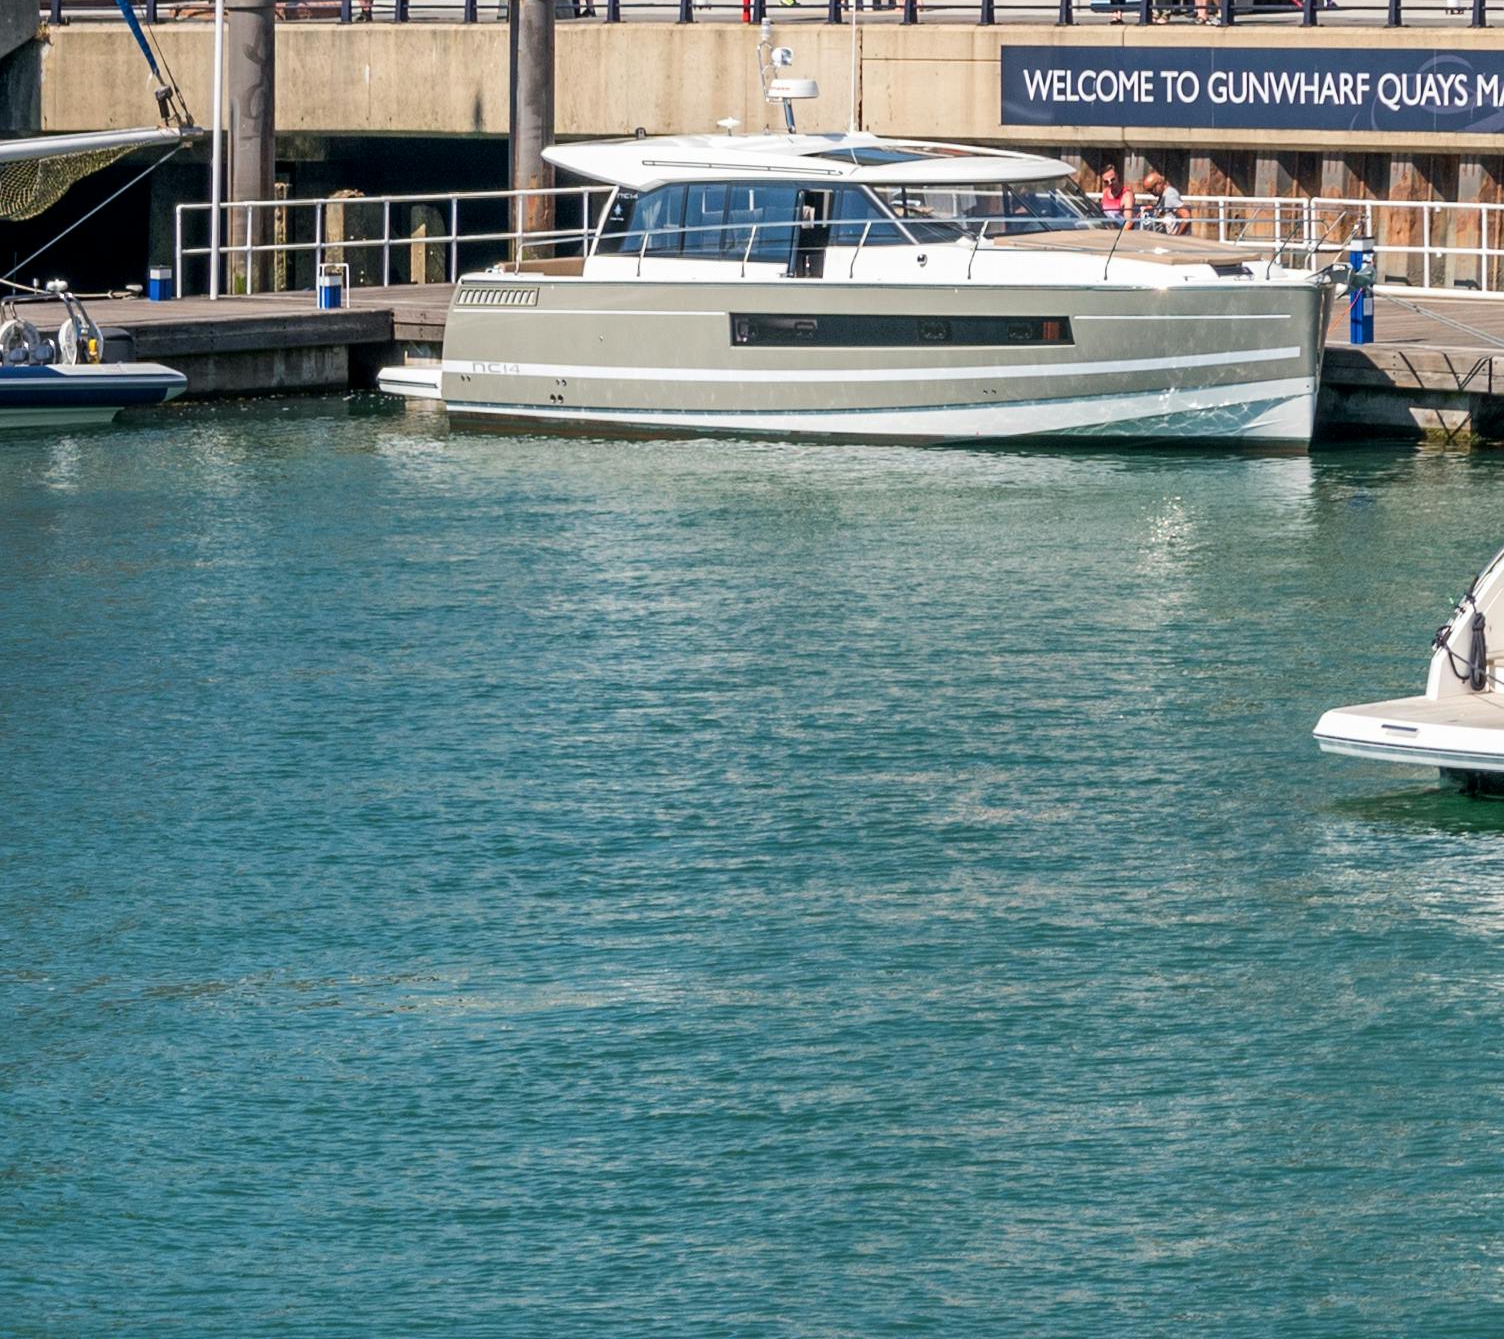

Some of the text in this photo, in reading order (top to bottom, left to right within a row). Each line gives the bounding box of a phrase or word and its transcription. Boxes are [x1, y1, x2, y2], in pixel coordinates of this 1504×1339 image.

[1023, 68, 1155, 103] WELCOME
[1160, 70, 1200, 103] TO
[1207, 70, 1371, 107] GUNWHARF
[1377, 72, 1470, 111] QUAYS
